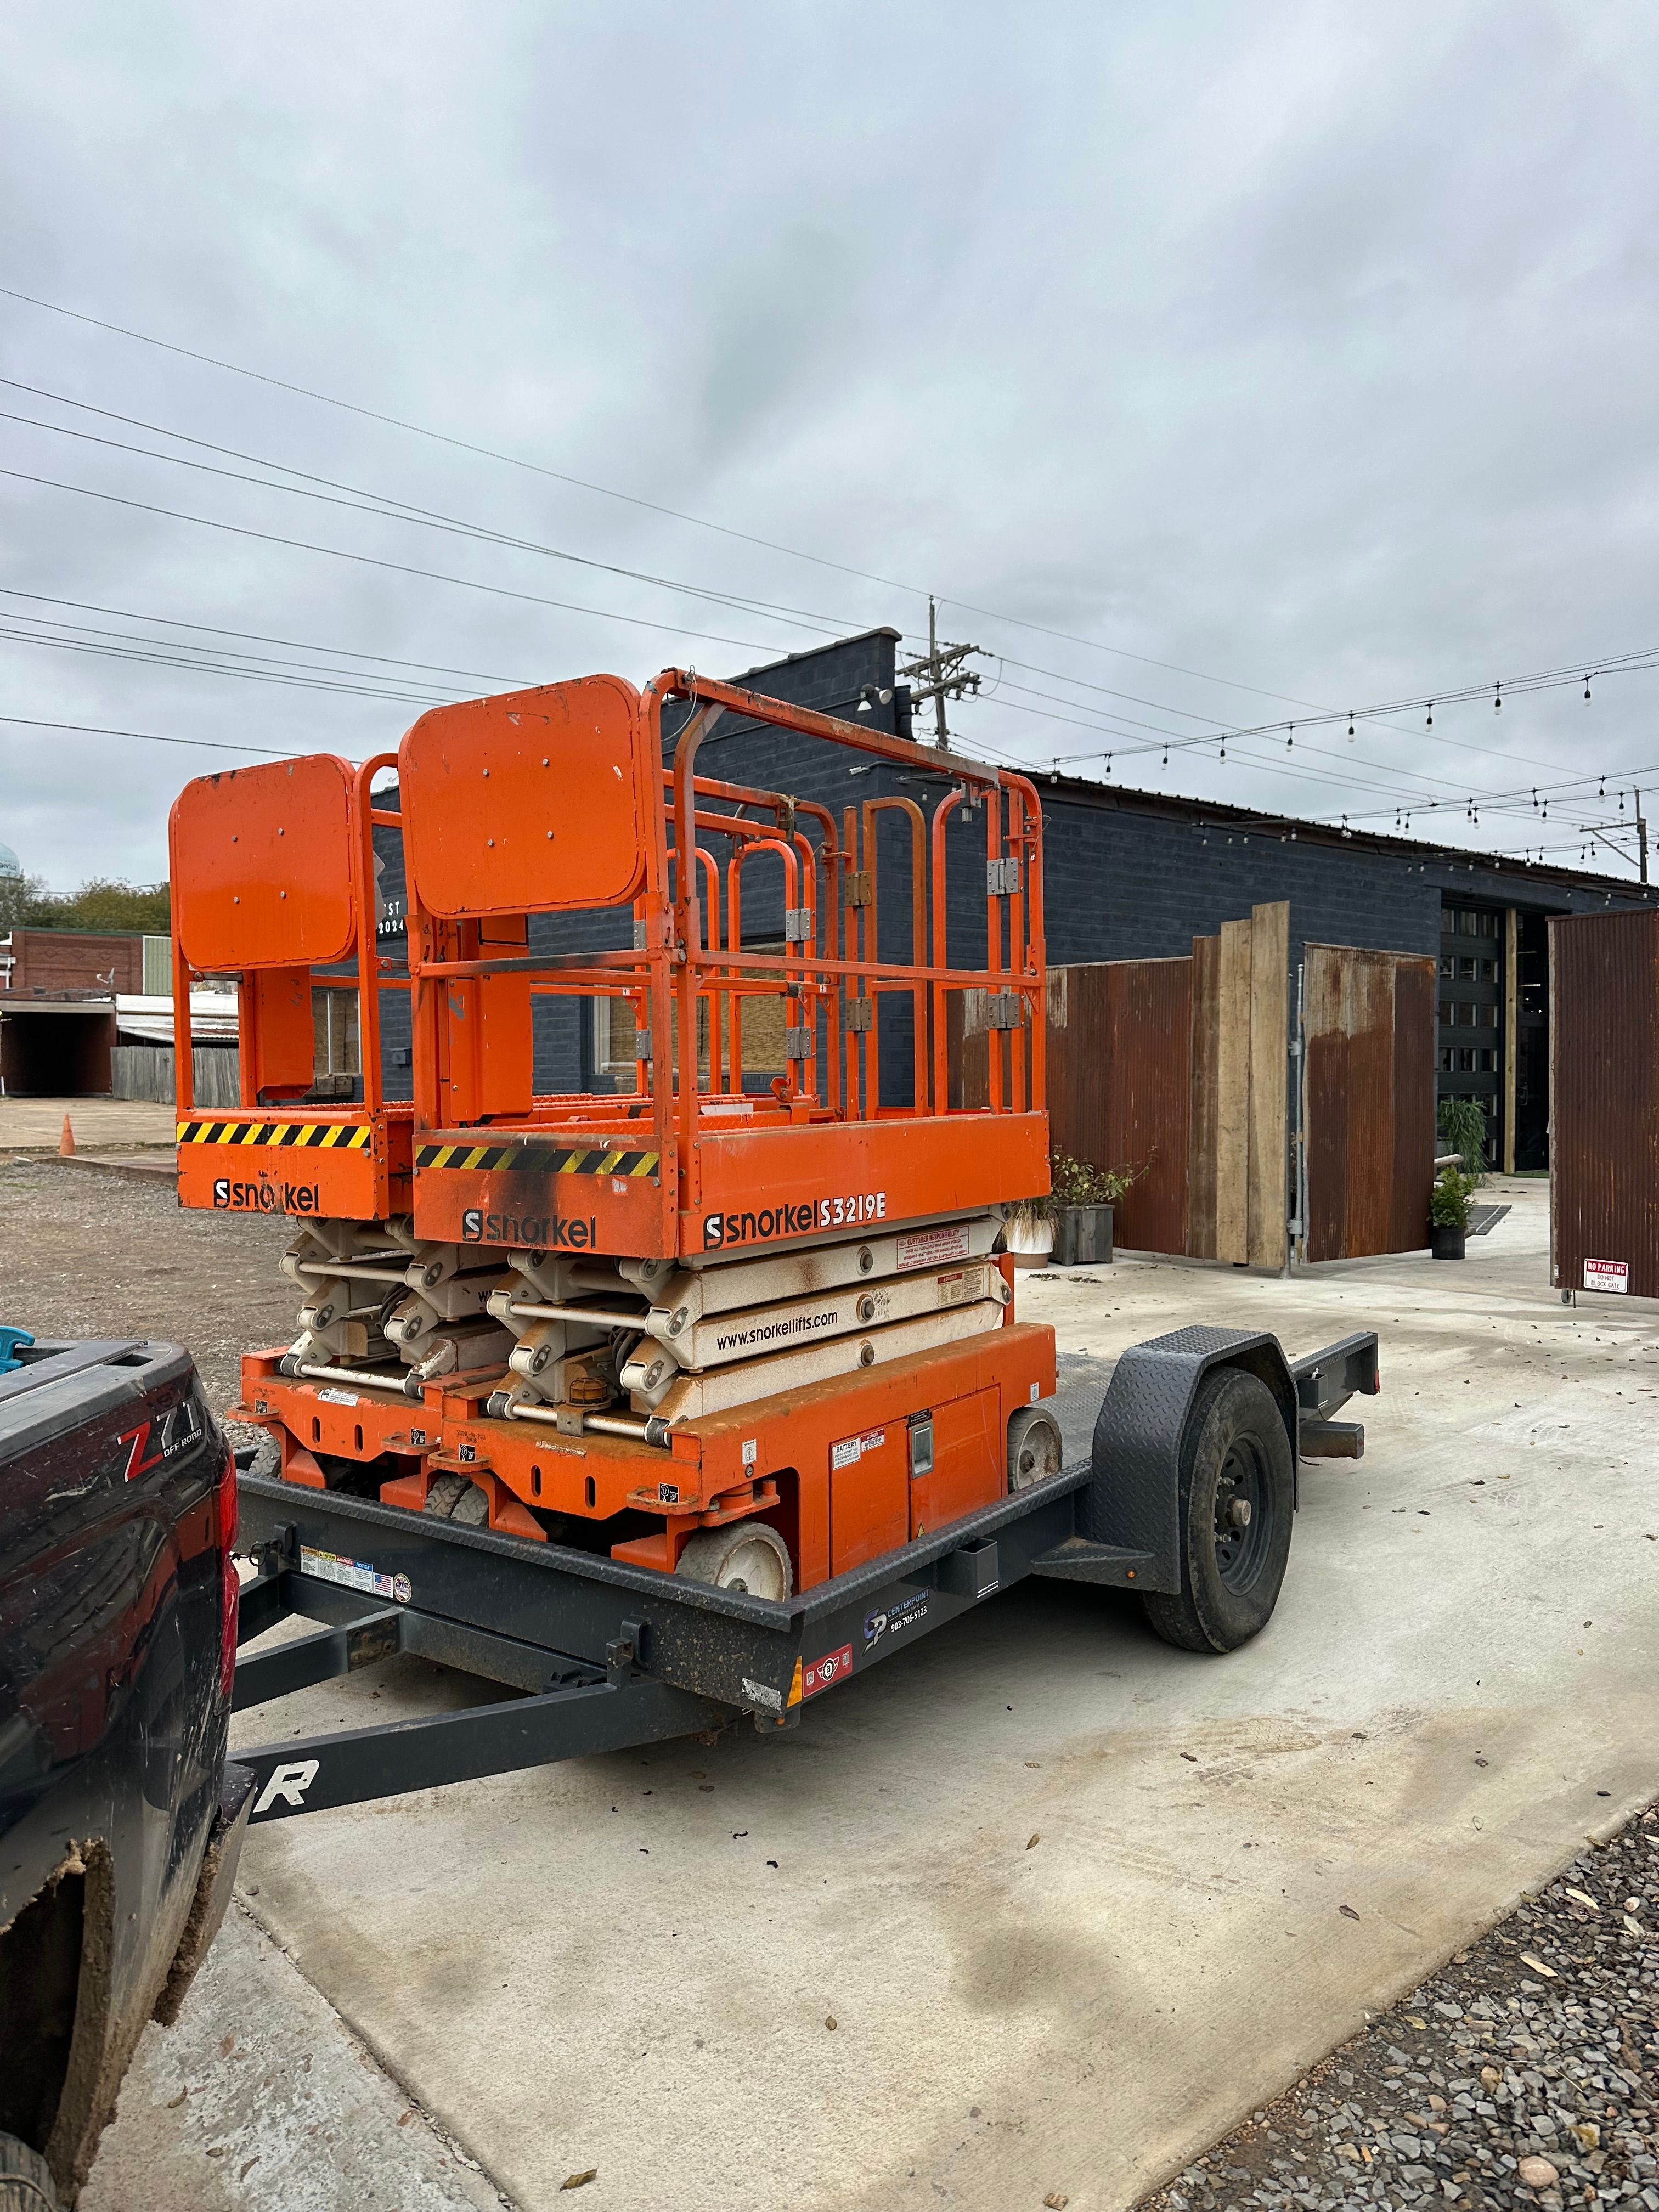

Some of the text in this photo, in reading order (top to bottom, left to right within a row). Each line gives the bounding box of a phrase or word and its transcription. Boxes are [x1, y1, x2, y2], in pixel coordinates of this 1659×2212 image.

[384, 901, 400, 916] ST
[379, 919, 404, 934] 2024
[233, 1182, 319, 1212] snokel
[487, 1214, 596, 1248] snorkel
[726, 1199, 818, 1243] snorkel
[820, 1192, 886, 1227] S3219E
[907, 1237, 929, 1245] CUSTOMER
[1588, 1262, 1624, 1274] NO PARKING
[716, 1311, 838, 1350] www.snorkellifts.com
[117, 1396, 200, 1483] Z71
[163, 1429, 202, 1458] OFF ROAD
[836, 1440, 857, 1453] BATTERY
[356, 1562, 370, 1570] NOTICE
[888, 1589, 930, 1617] CENTERPOINT
[891, 1606, 927, 1633] 903-706-5123
[253, 1759, 320, 1813] R
